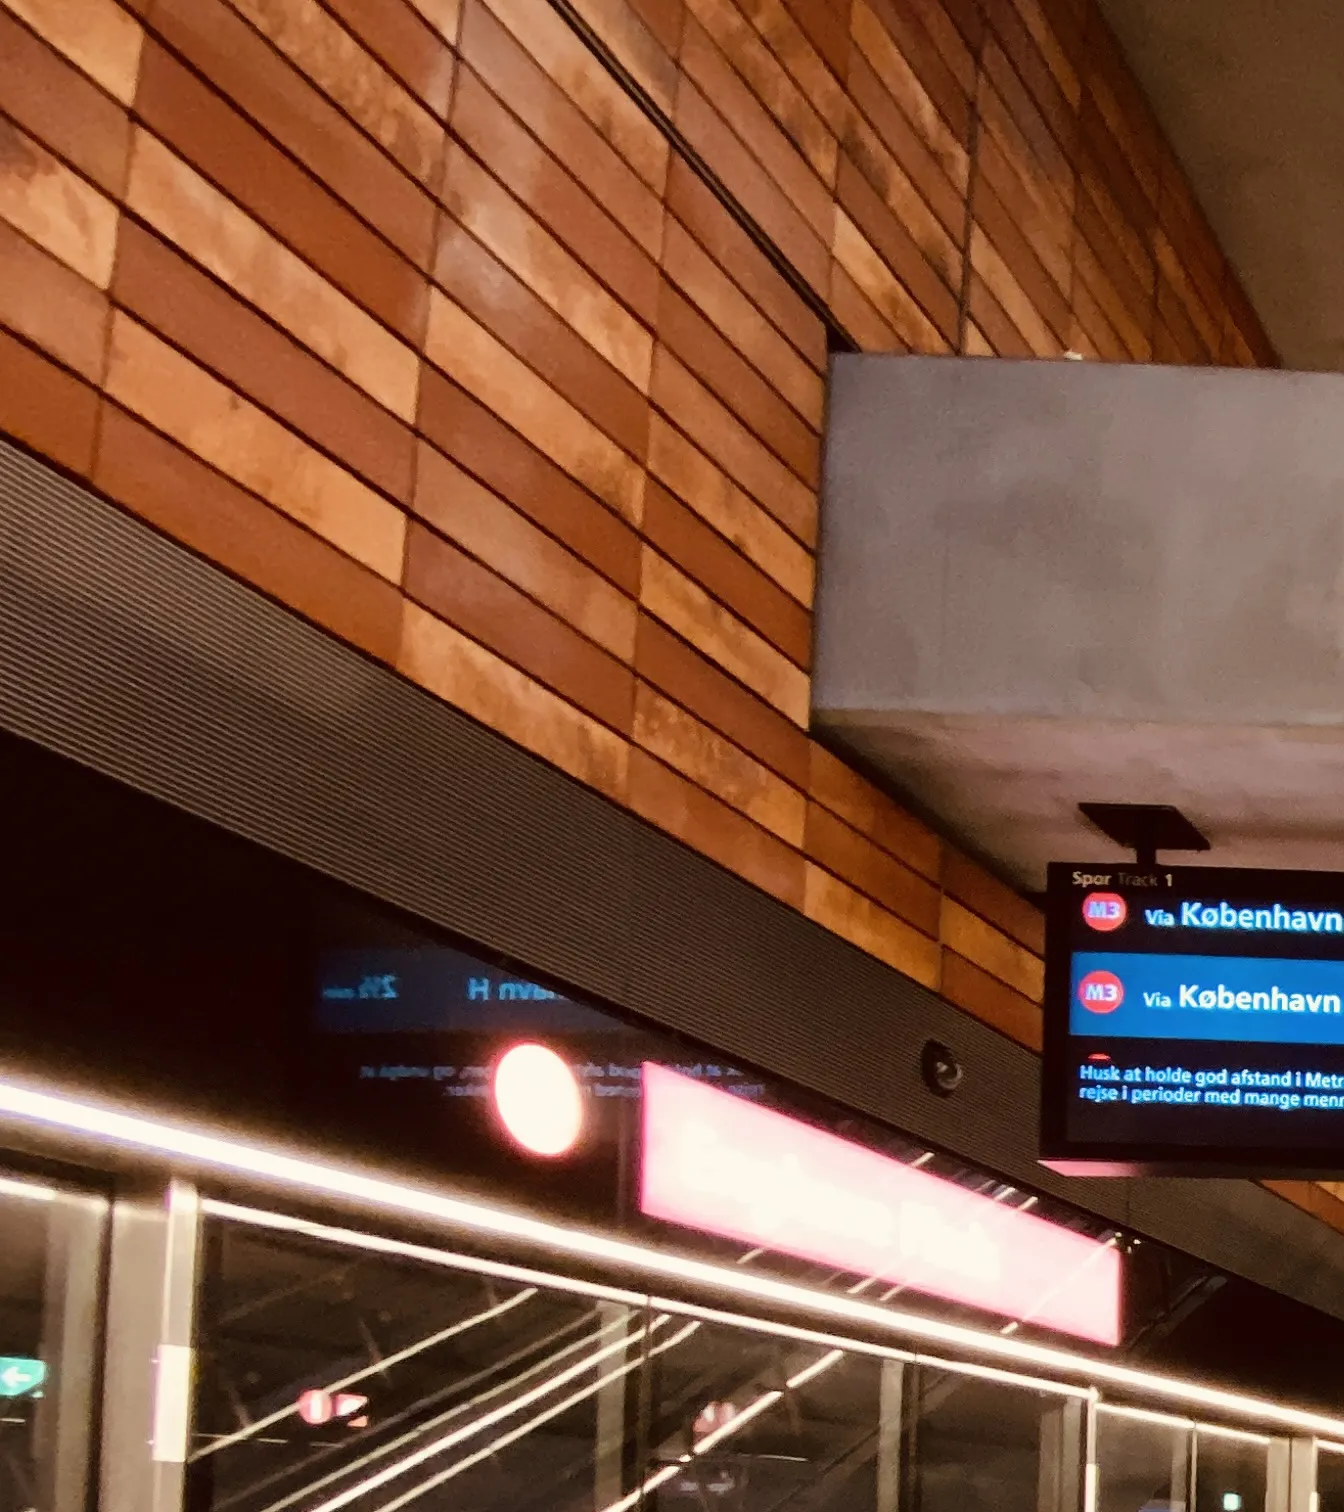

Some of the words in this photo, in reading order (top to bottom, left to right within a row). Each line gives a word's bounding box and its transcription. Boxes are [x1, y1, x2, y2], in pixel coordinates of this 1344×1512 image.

[1072, 871, 1111, 887] Spor
[1118, 872, 1158, 887] Track
[1165, 873, 1173, 887] 1
[1087, 901, 1120, 918] M3
[1145, 909, 1174, 926] Via
[1181, 902, 1343, 932] København
[1085, 984, 1117, 1001] M3
[1143, 992, 1171, 1008] Via
[1179, 984, 1340, 1014] København
[1080, 1065, 1120, 1081] Husk
[1124, 1067, 1141, 1082] at
[1145, 1066, 1191, 1084] holde
[1195, 1068, 1227, 1087] god
[1231, 1069, 1291, 1087] afstand
[1079, 1085, 1118, 1102] rejse
[1131, 1086, 1200, 1104] perioder
[1204, 1088, 1240, 1105] med
[1244, 1092, 1299, 1110] mange
